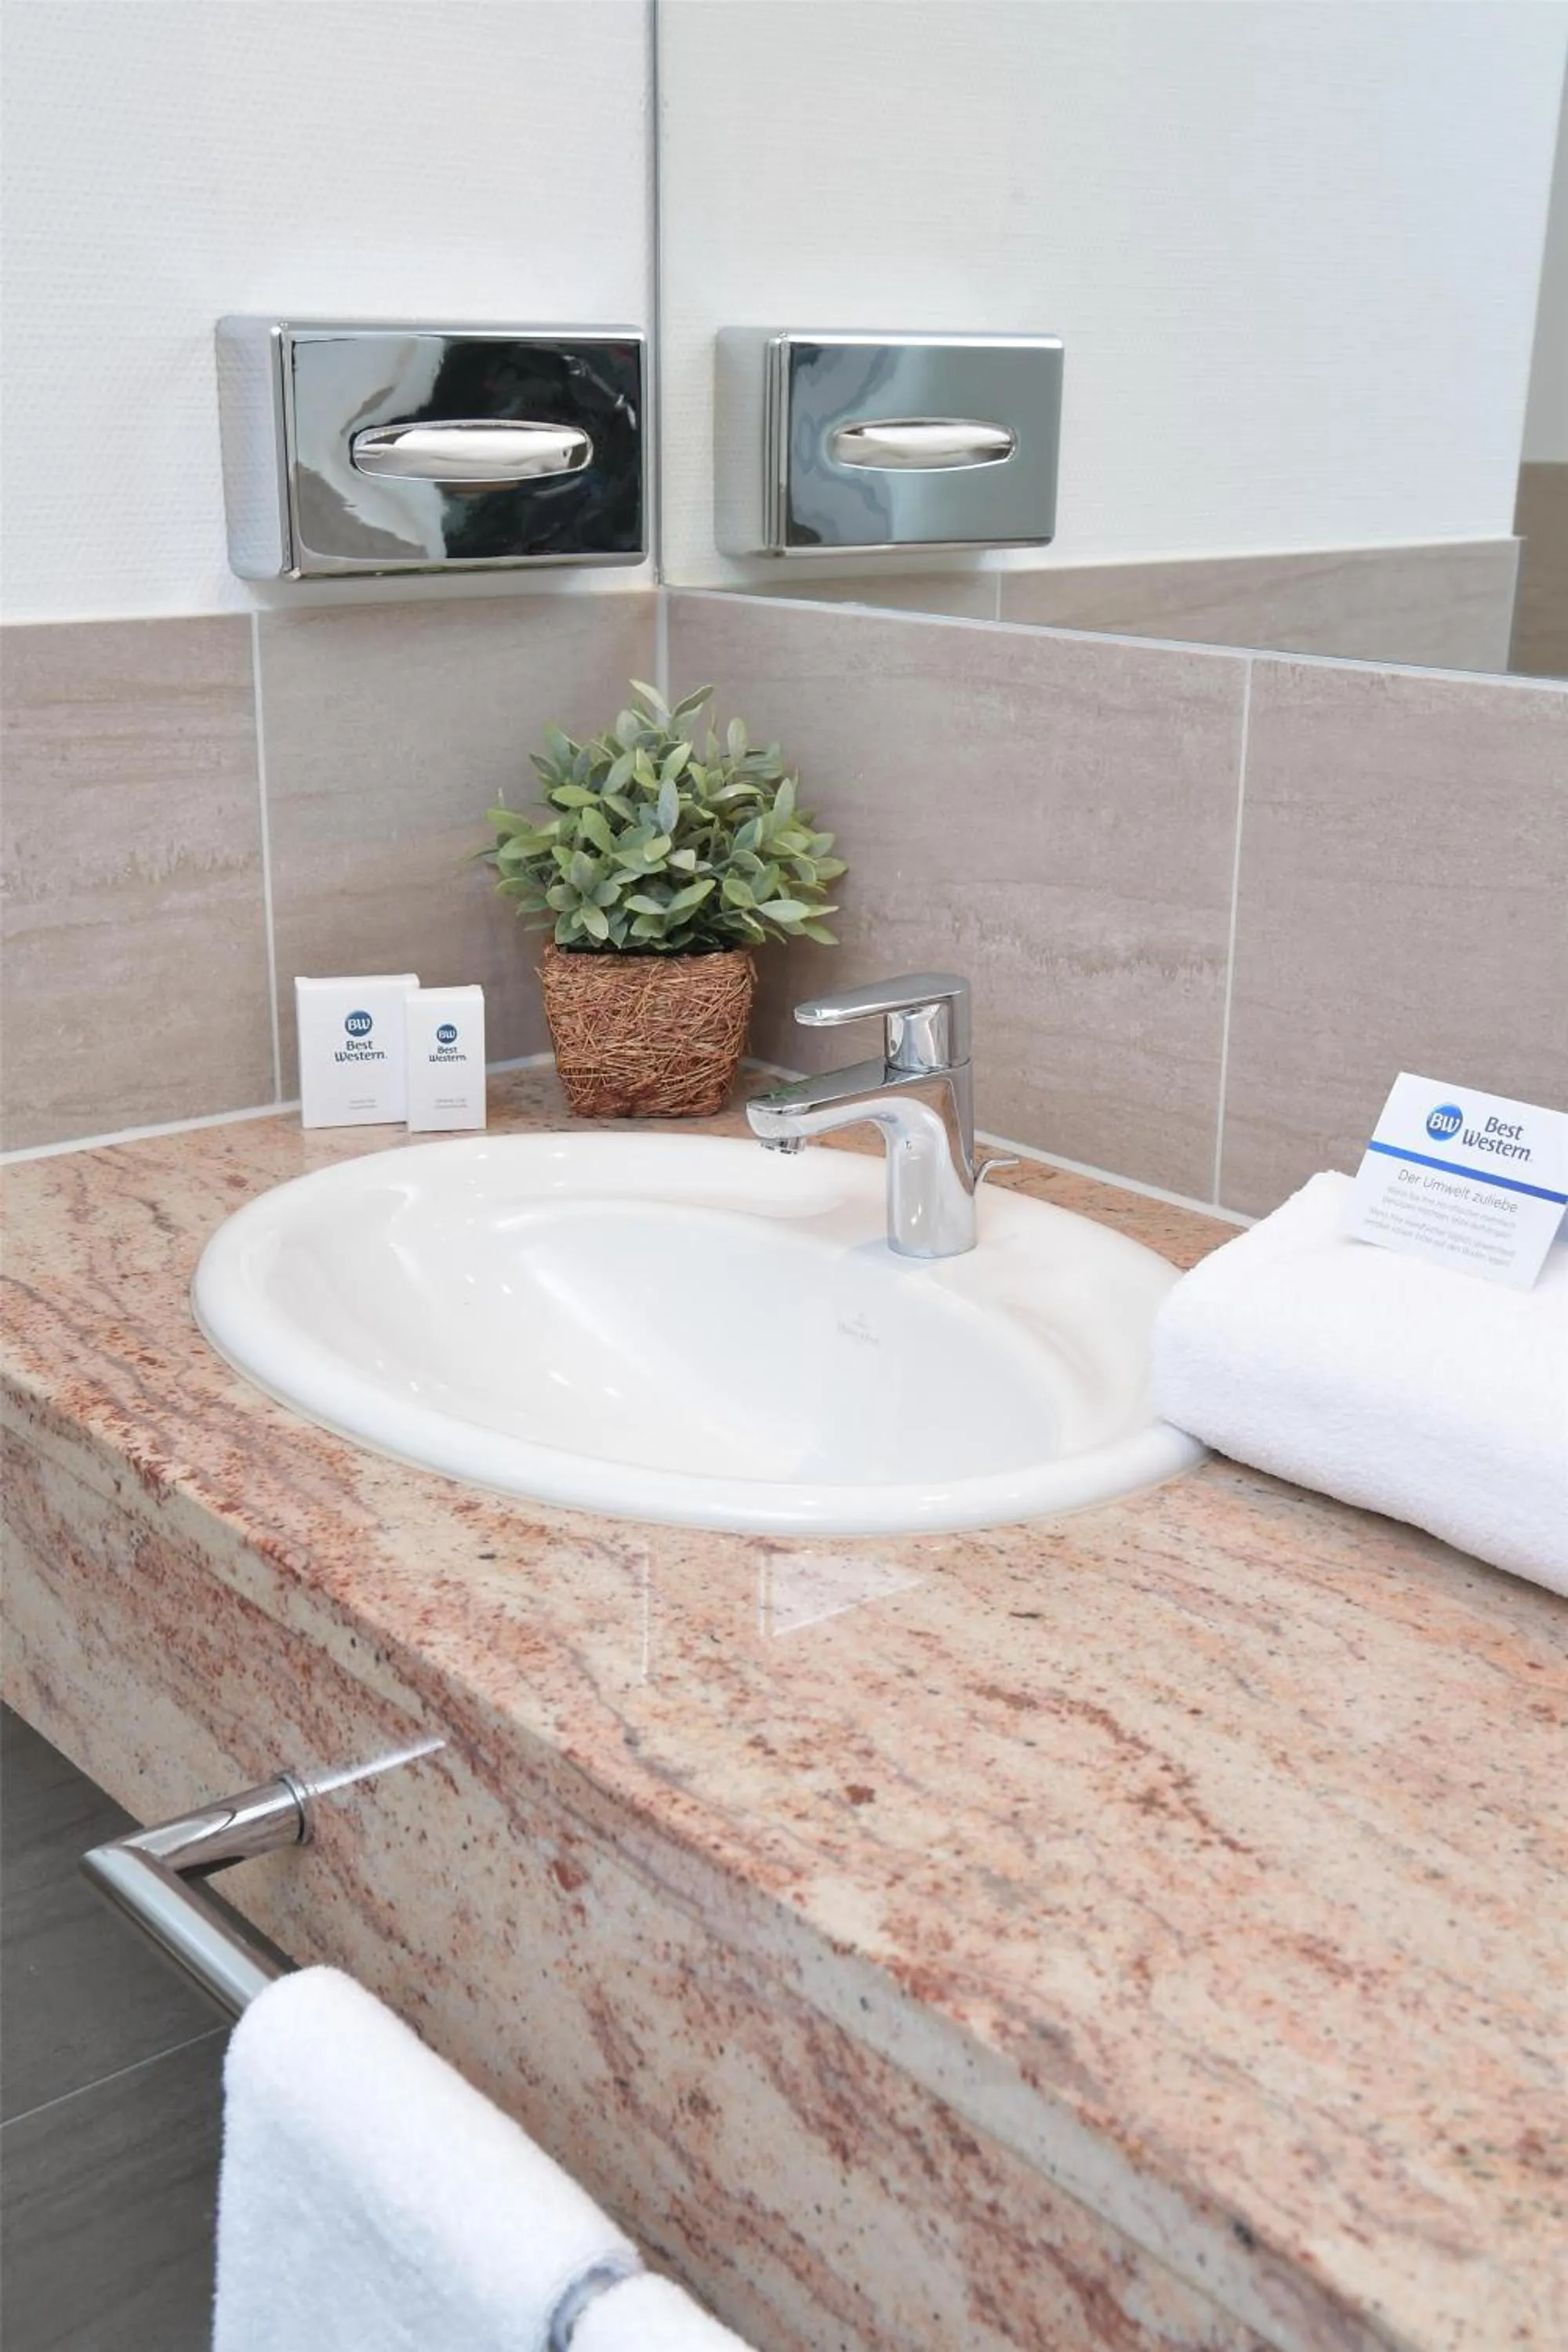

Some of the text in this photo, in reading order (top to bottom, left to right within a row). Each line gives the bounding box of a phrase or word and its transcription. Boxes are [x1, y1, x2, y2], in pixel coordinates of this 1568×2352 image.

[347, 1018, 372, 1031] BW
[438, 1029, 456, 1040] BW
[346, 1040, 373, 1051] Best
[437, 1046, 457, 1054] Best
[429, 1054, 466, 1062] Western
[1428, 1112, 1460, 1133] BW
[1484, 1116, 1523, 1141] Best
[1398, 1168, 1421, 1185] Der
[1423, 1178, 1471, 1200] Umwelt
[1472, 1192, 1519, 1214] zuliebe
